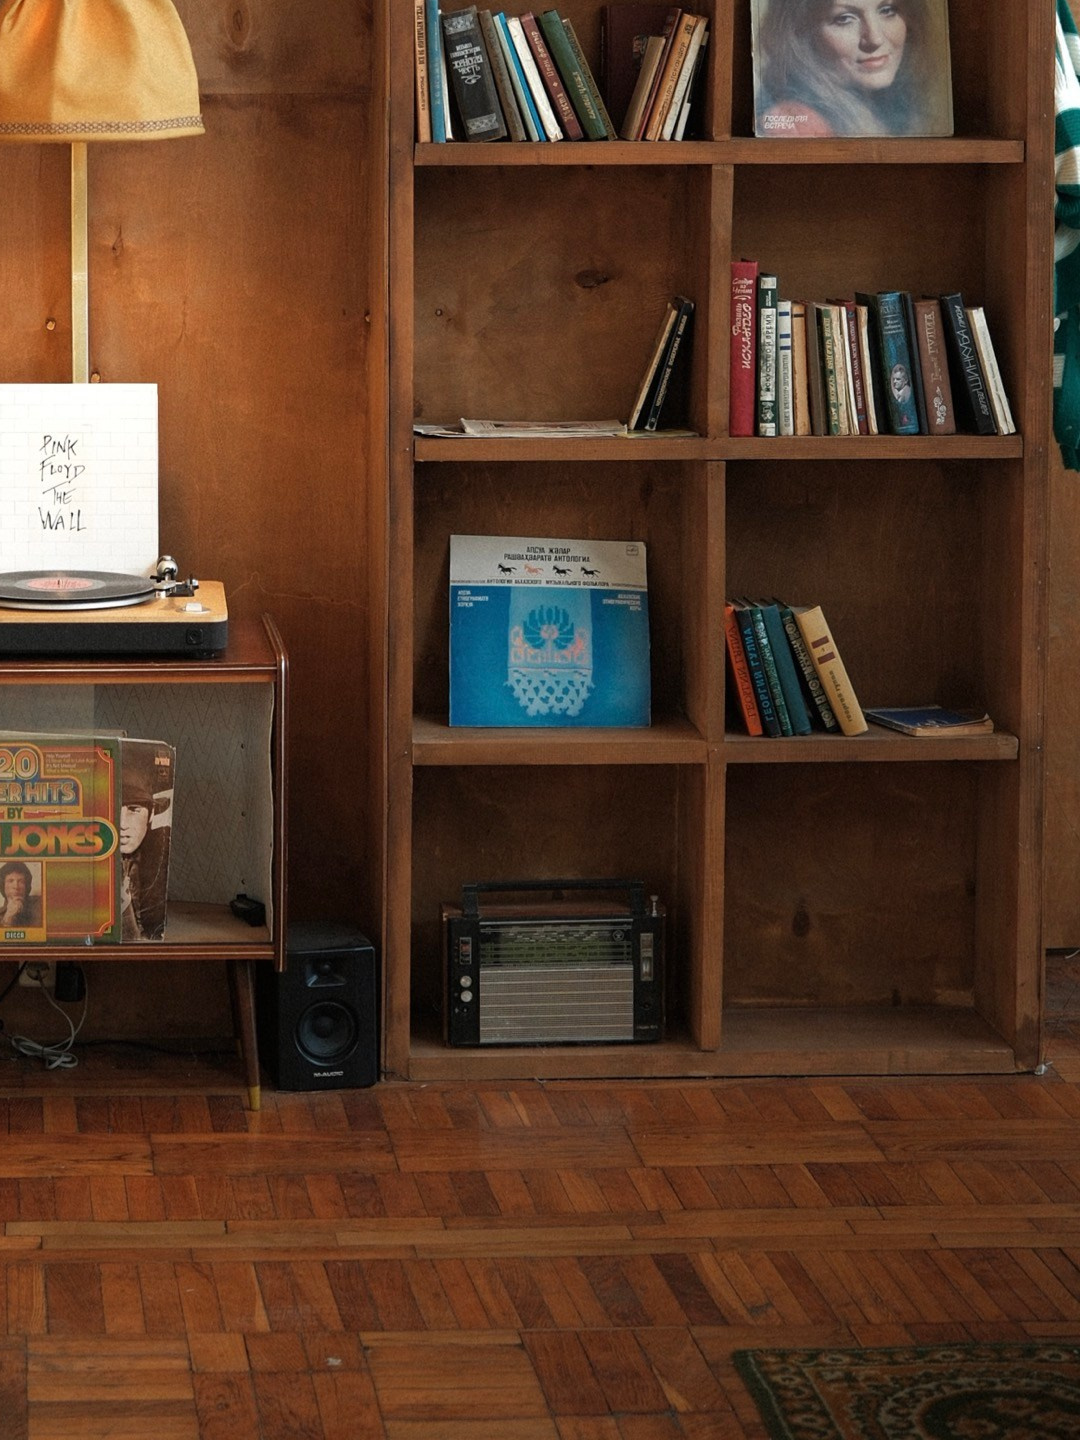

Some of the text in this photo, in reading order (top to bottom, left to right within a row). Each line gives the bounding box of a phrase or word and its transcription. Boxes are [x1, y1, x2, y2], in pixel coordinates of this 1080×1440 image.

[764, 122, 796, 130] ВСТРЕЧА
[733, 303, 742, 336] Фазиль
[956, 328, 983, 392] ШИНКУБА
[39, 434, 78, 460] PINK
[40, 455, 86, 483] FLOYD
[42, 482, 76, 506] THE
[38, 506, 87, 532] WALL
[726, 625, 758, 718] ГЕОРГИЙ ГУЛИА
[743, 627, 774, 722] ГЕОРГИЙ ГУЛИА
[24, 782, 76, 803] HITS
[6, 807, 24, 820] BY
[4, 824, 104, 856] JONES
